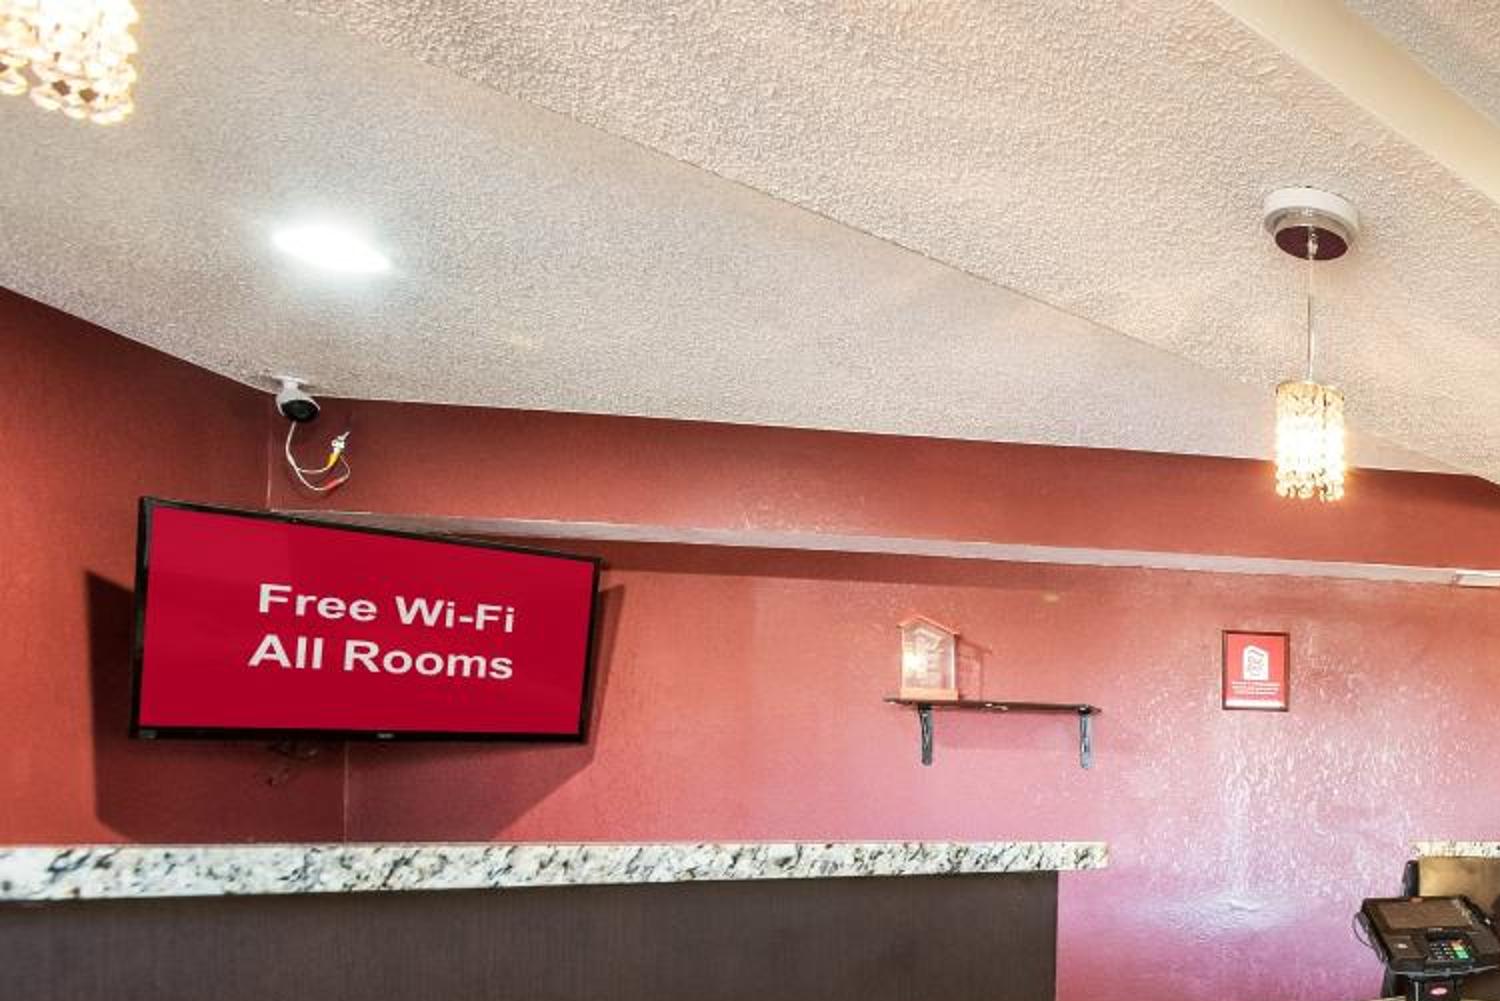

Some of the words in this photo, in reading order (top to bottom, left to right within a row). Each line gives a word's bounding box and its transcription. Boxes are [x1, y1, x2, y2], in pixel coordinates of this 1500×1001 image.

[258, 583, 378, 622] Free
[395, 595, 515, 634] Wi-Fi
[248, 633, 324, 669] All
[343, 639, 513, 680] Rooms
